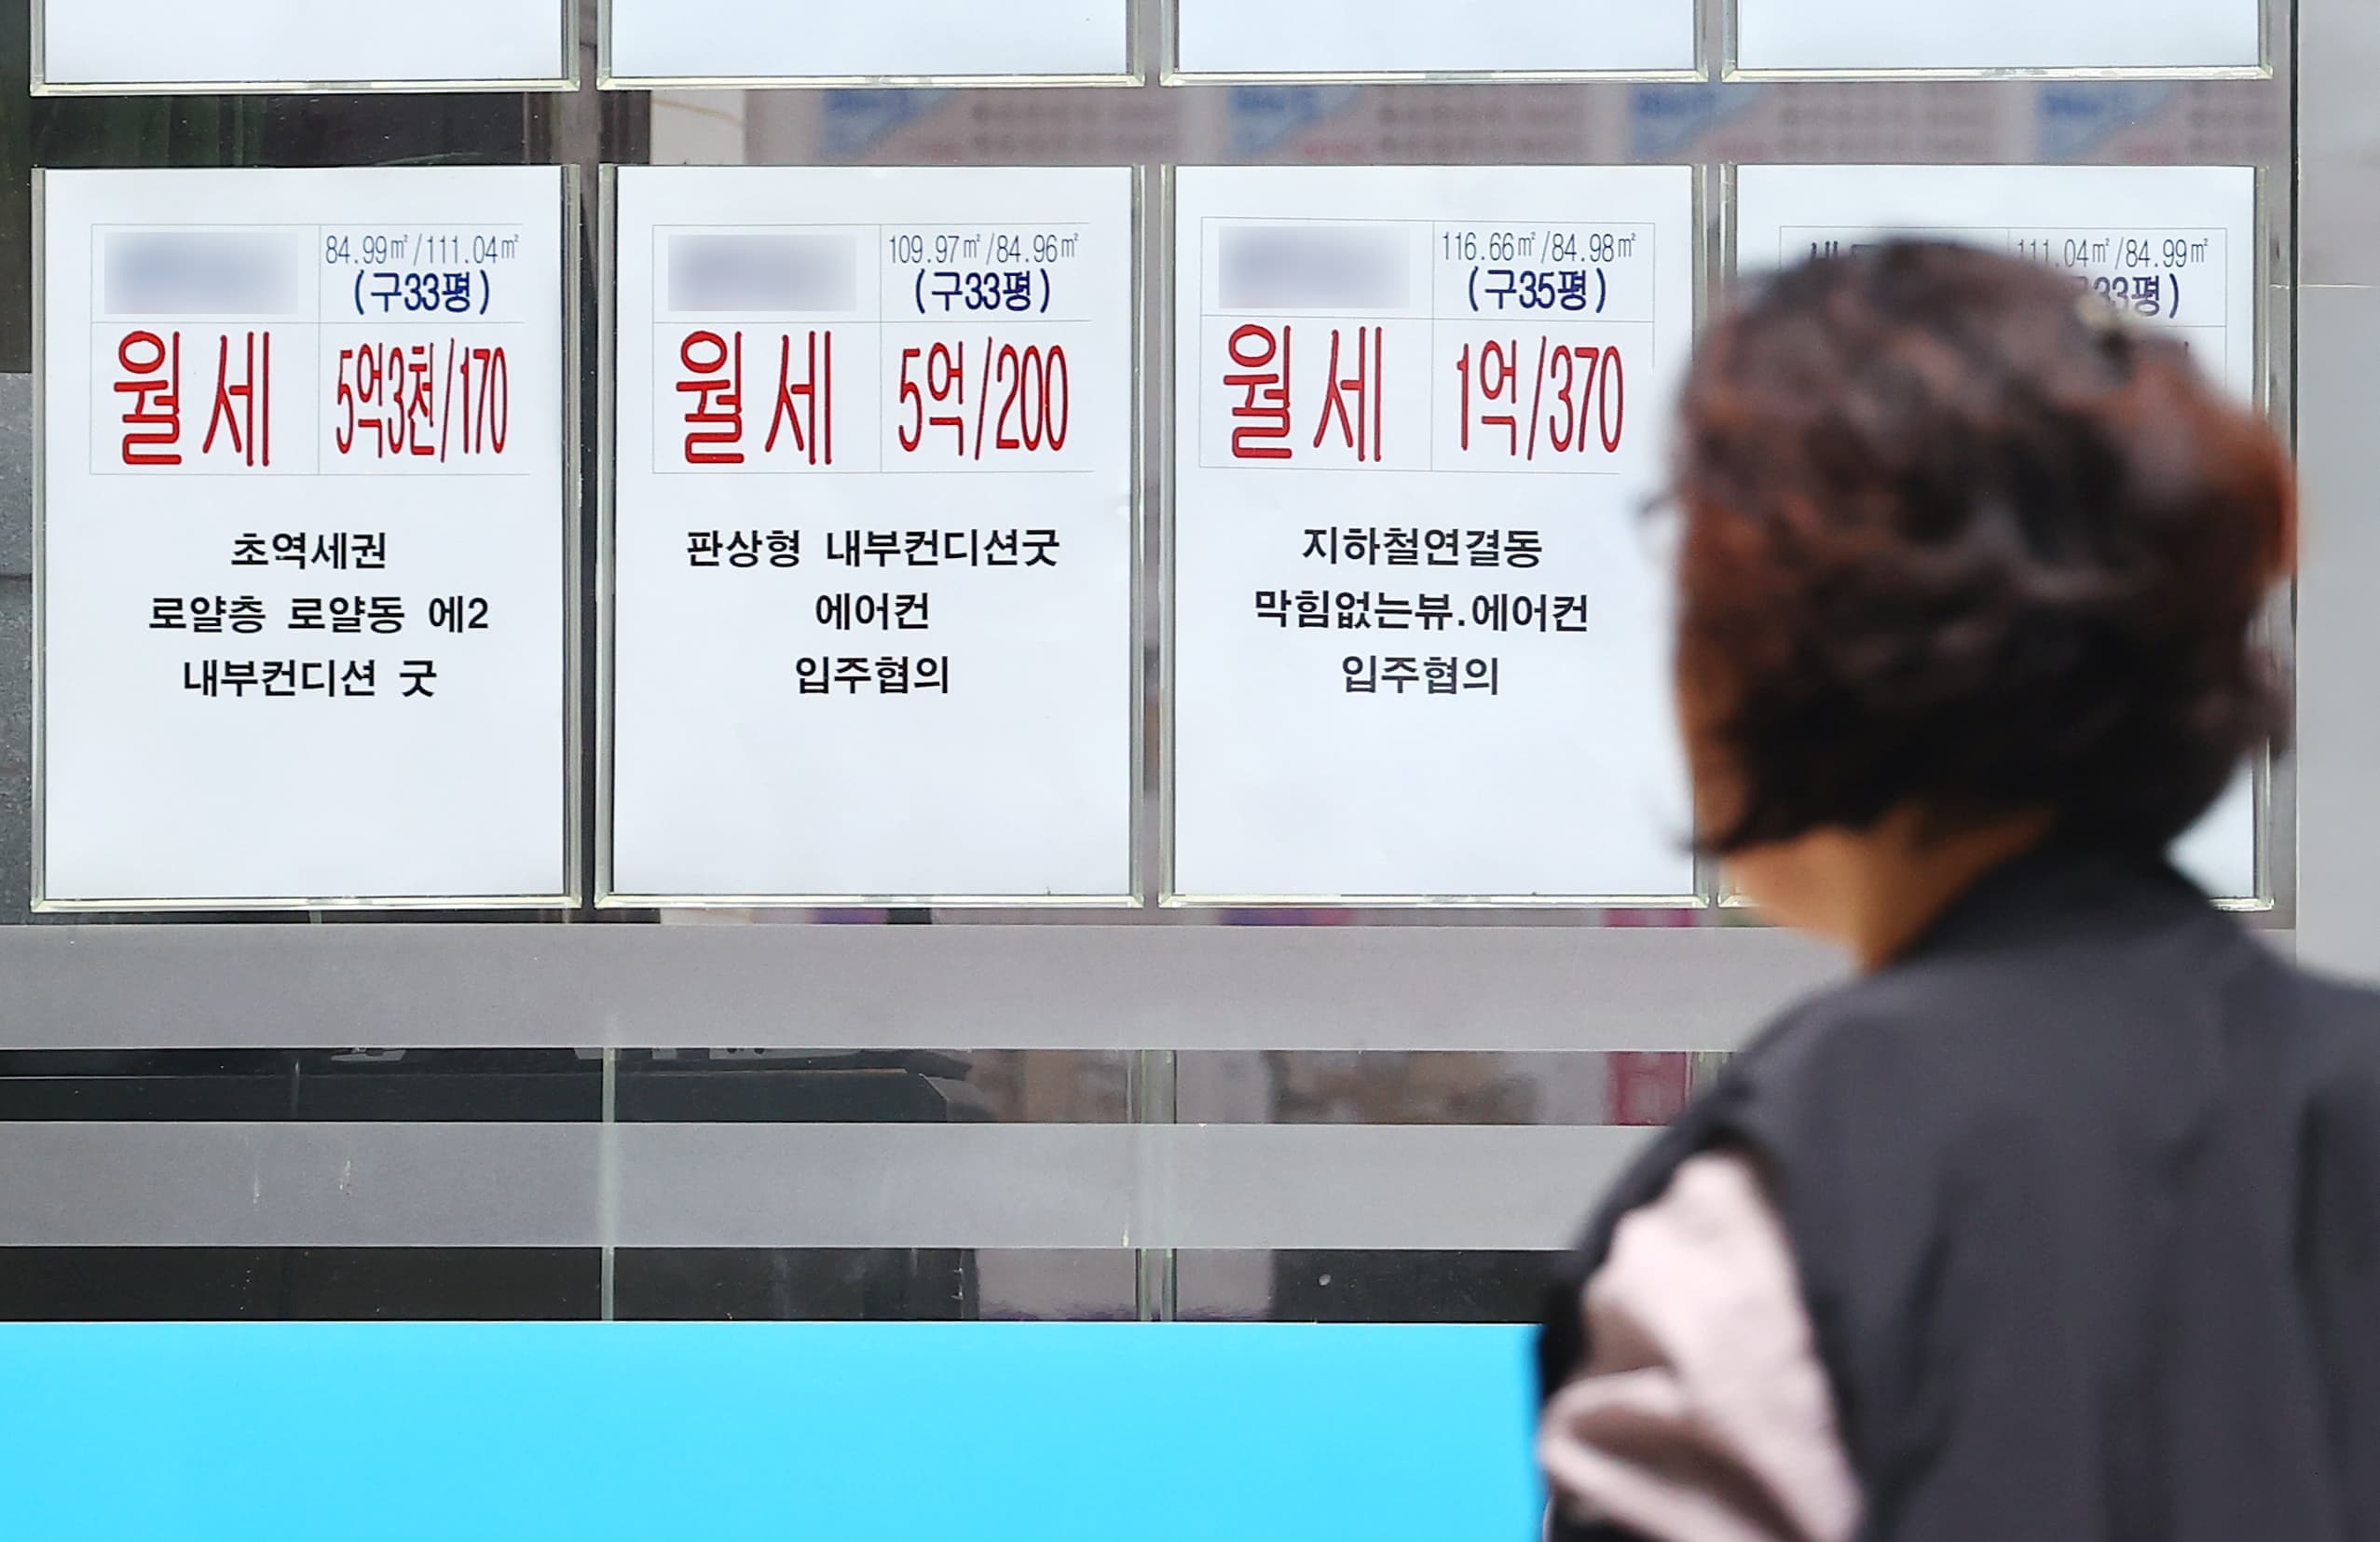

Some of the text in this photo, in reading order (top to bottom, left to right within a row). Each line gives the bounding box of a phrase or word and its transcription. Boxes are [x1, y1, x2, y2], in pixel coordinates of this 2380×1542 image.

[354, 269, 489, 315] (구33평)
[915, 268, 1050, 314] (구33평)
[1469, 266, 1606, 313] (구35평)
[335, 337, 507, 463] 5억3천/170
[898, 336, 1068, 461] 5억/200
[1457, 335, 1623, 461] 1억/370
[231, 532, 386, 570] 초역세권
[687, 529, 1060, 567] 판상형 내부컨디션굿
[1302, 526, 1542, 568] 지하철연결동
[149, 595, 488, 634] 로얄층 로얄동 에2
[815, 593, 928, 631] 에어컨
[1255, 590, 1587, 633] 막힘없는뷰.에어컨
[185, 660, 437, 697] 내부컨디션 굿
[796, 656, 948, 694] 입주협의
[1342, 655, 1498, 695] 입주협의
